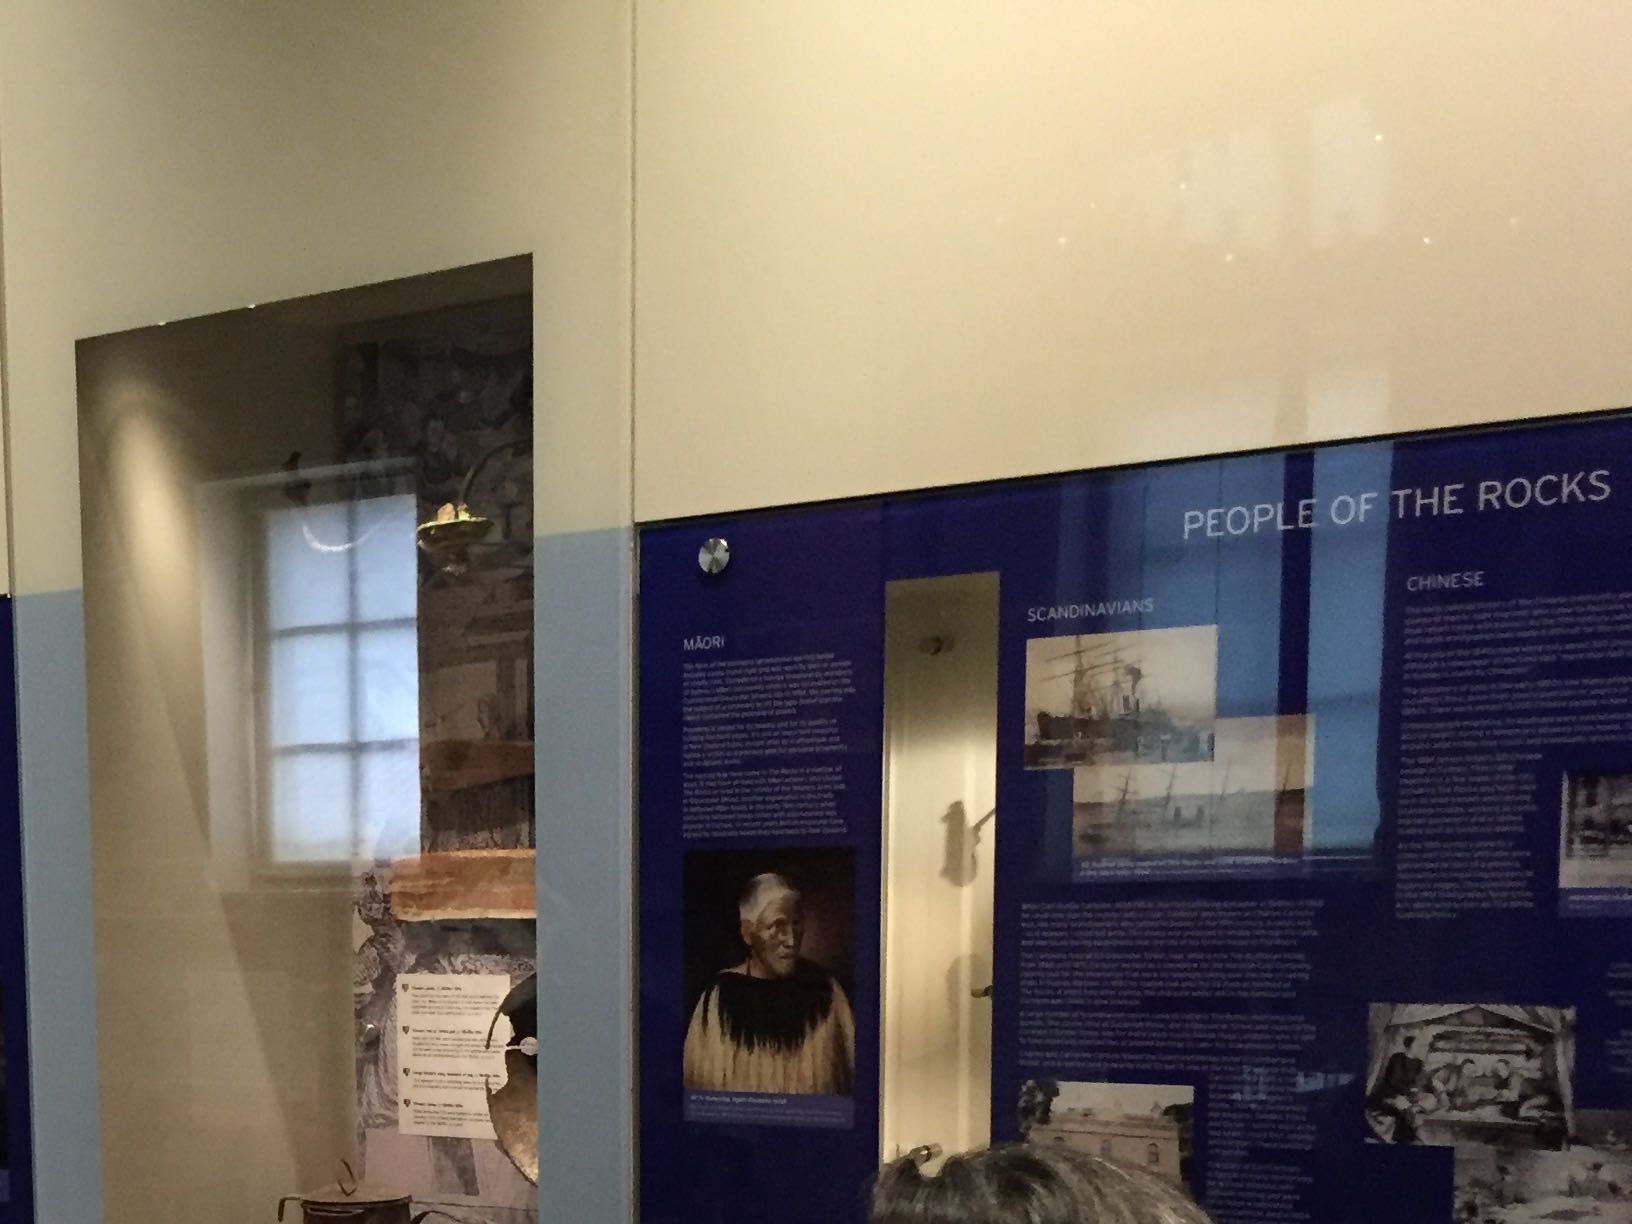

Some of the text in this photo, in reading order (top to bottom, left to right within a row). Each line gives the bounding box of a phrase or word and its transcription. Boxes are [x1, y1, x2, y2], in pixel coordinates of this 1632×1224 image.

[1182, 469, 1612, 541] PEOPLE OF THE ROCKS
[1407, 571, 1486, 592] CHINESE
[1027, 597, 1155, 622] SCANDINAVIANS
